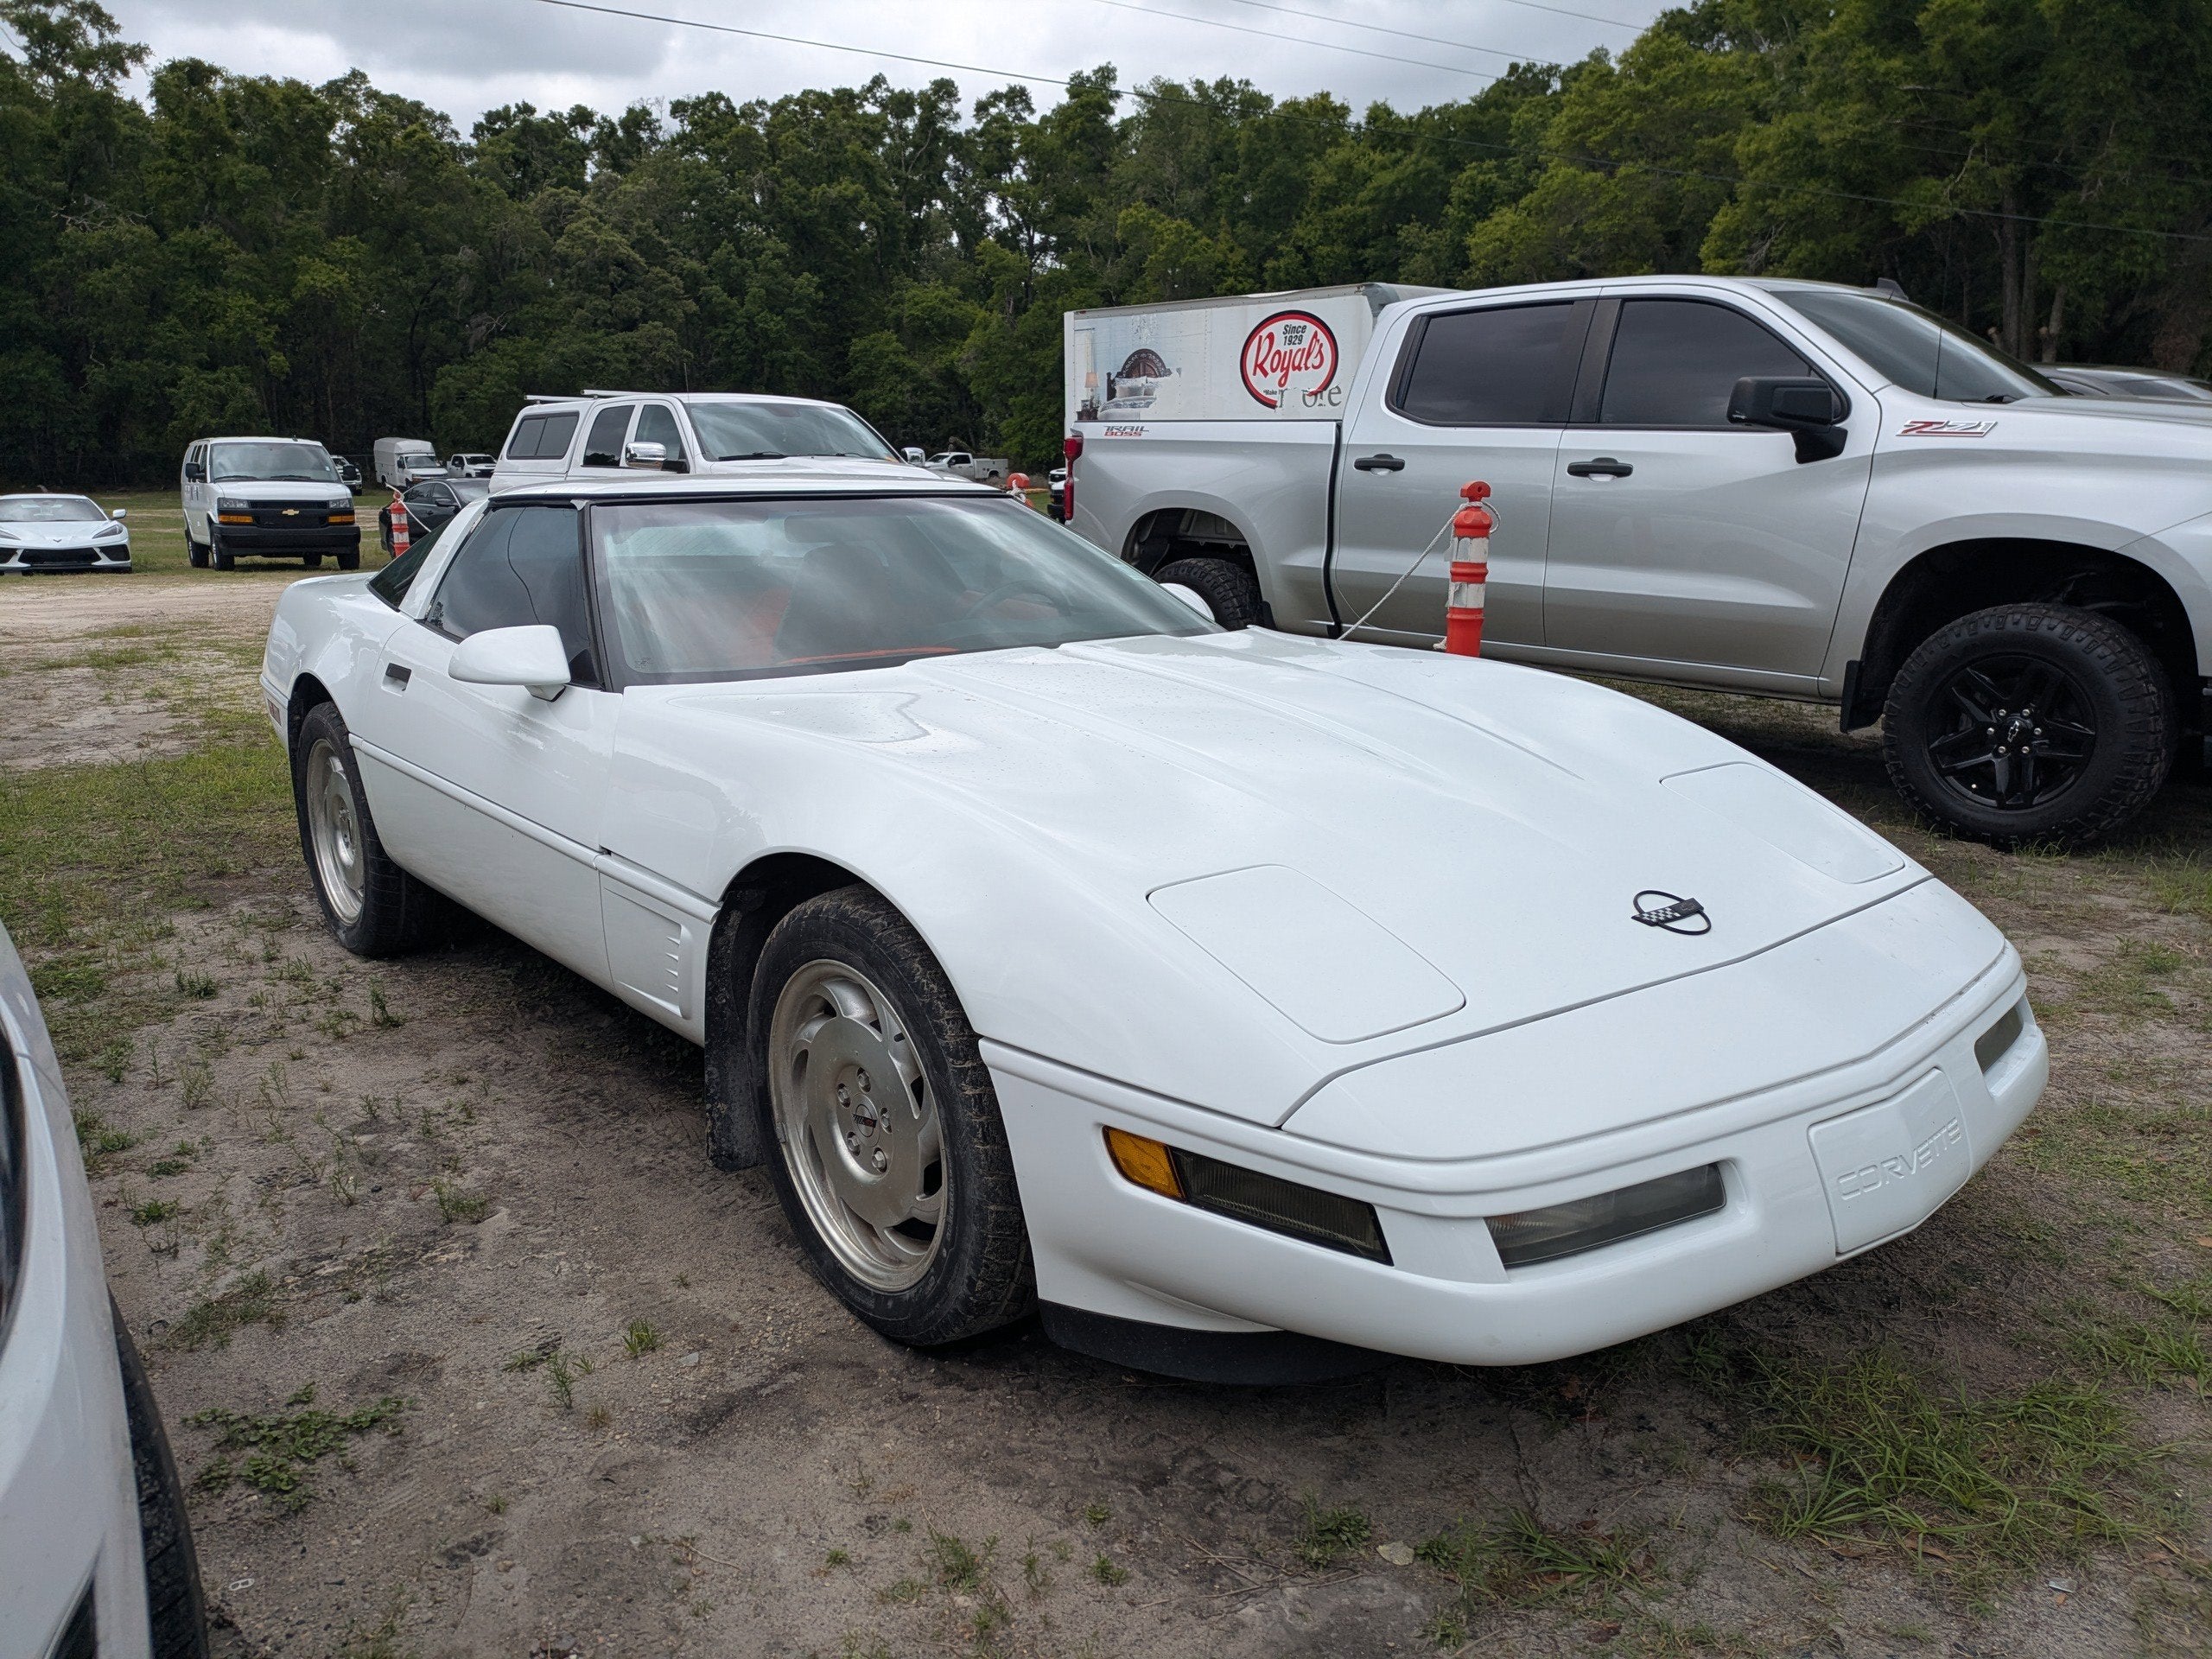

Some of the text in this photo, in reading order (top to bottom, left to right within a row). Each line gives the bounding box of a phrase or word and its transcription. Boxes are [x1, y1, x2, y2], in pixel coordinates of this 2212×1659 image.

[1282, 324, 1307, 335] Since
[1283, 334, 1303, 346] 1929
[1252, 330, 1325, 388] Royal's
[1836, 1116, 1961, 1201] CORVETTE
